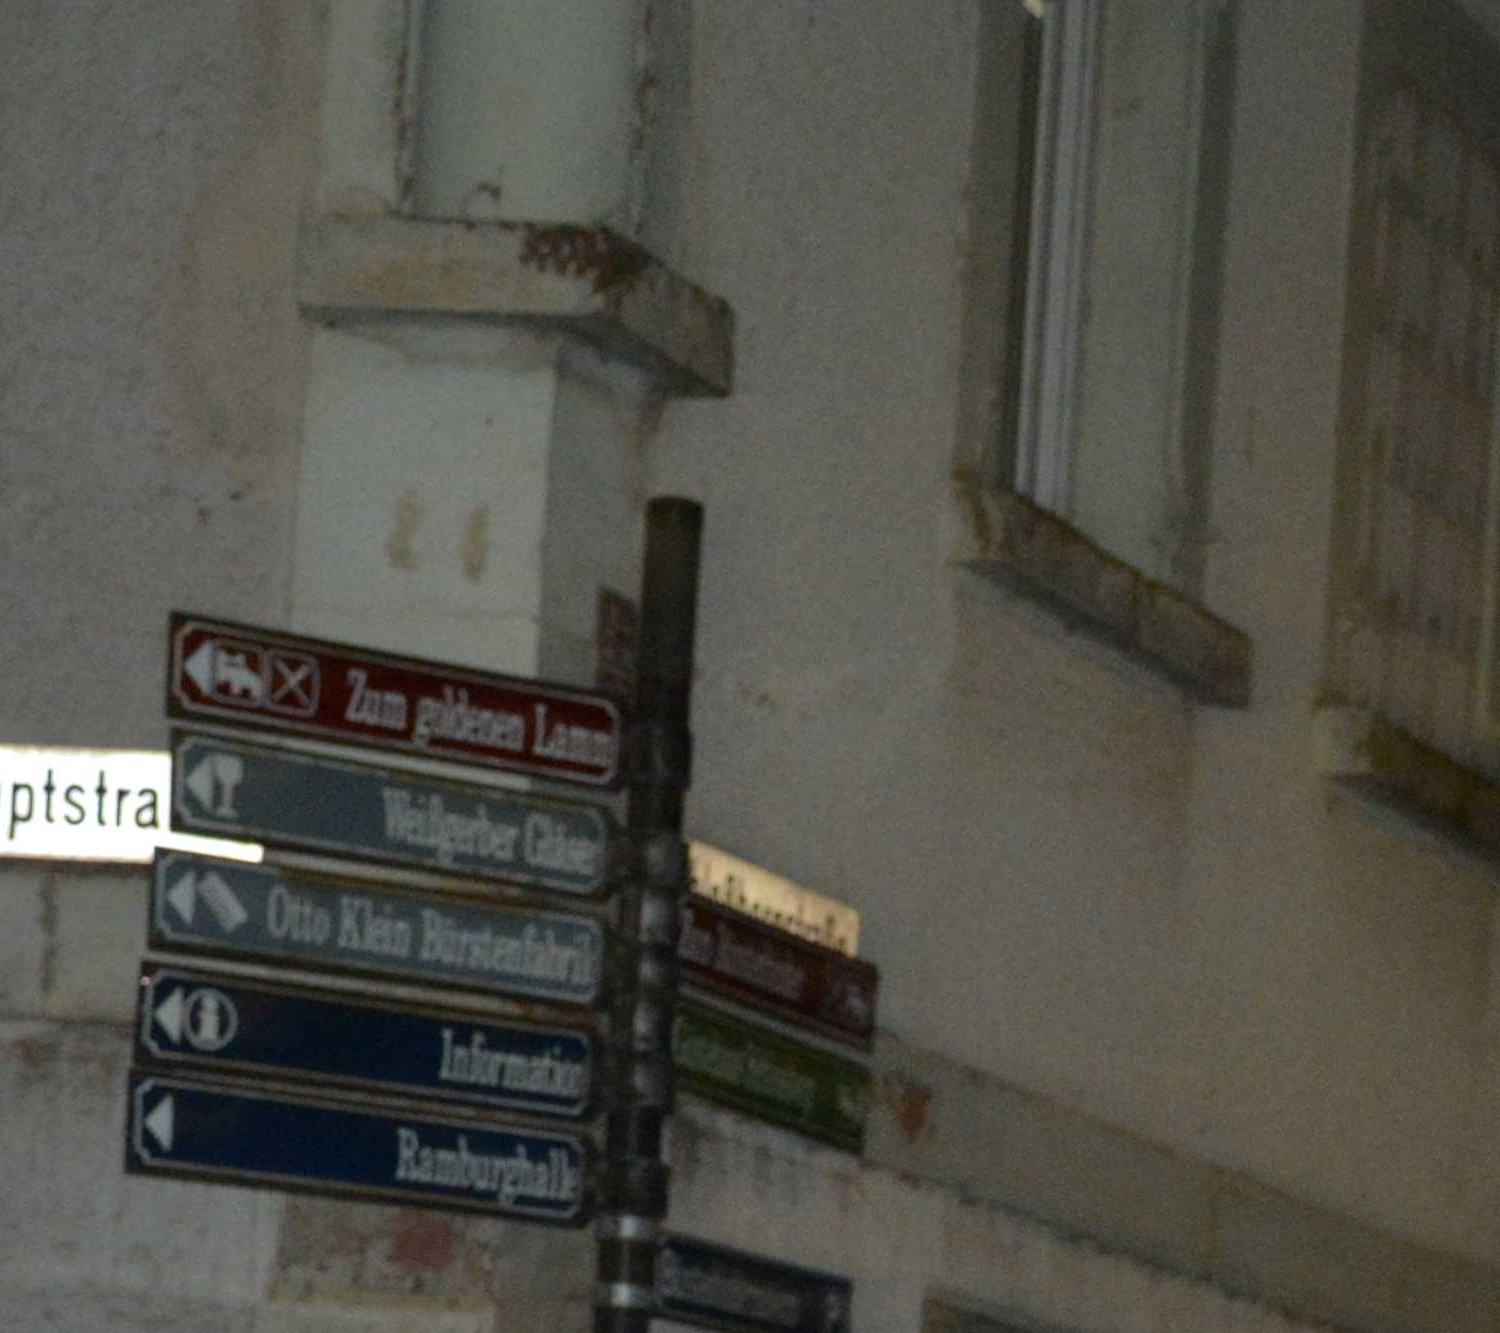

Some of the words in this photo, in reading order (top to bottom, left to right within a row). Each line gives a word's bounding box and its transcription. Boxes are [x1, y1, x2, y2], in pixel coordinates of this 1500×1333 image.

[345, 668, 408, 731] Zum
[266, 885, 331, 946] Otto
[337, 894, 411, 959] Klein
[438, 1027, 582, 1098] Information
